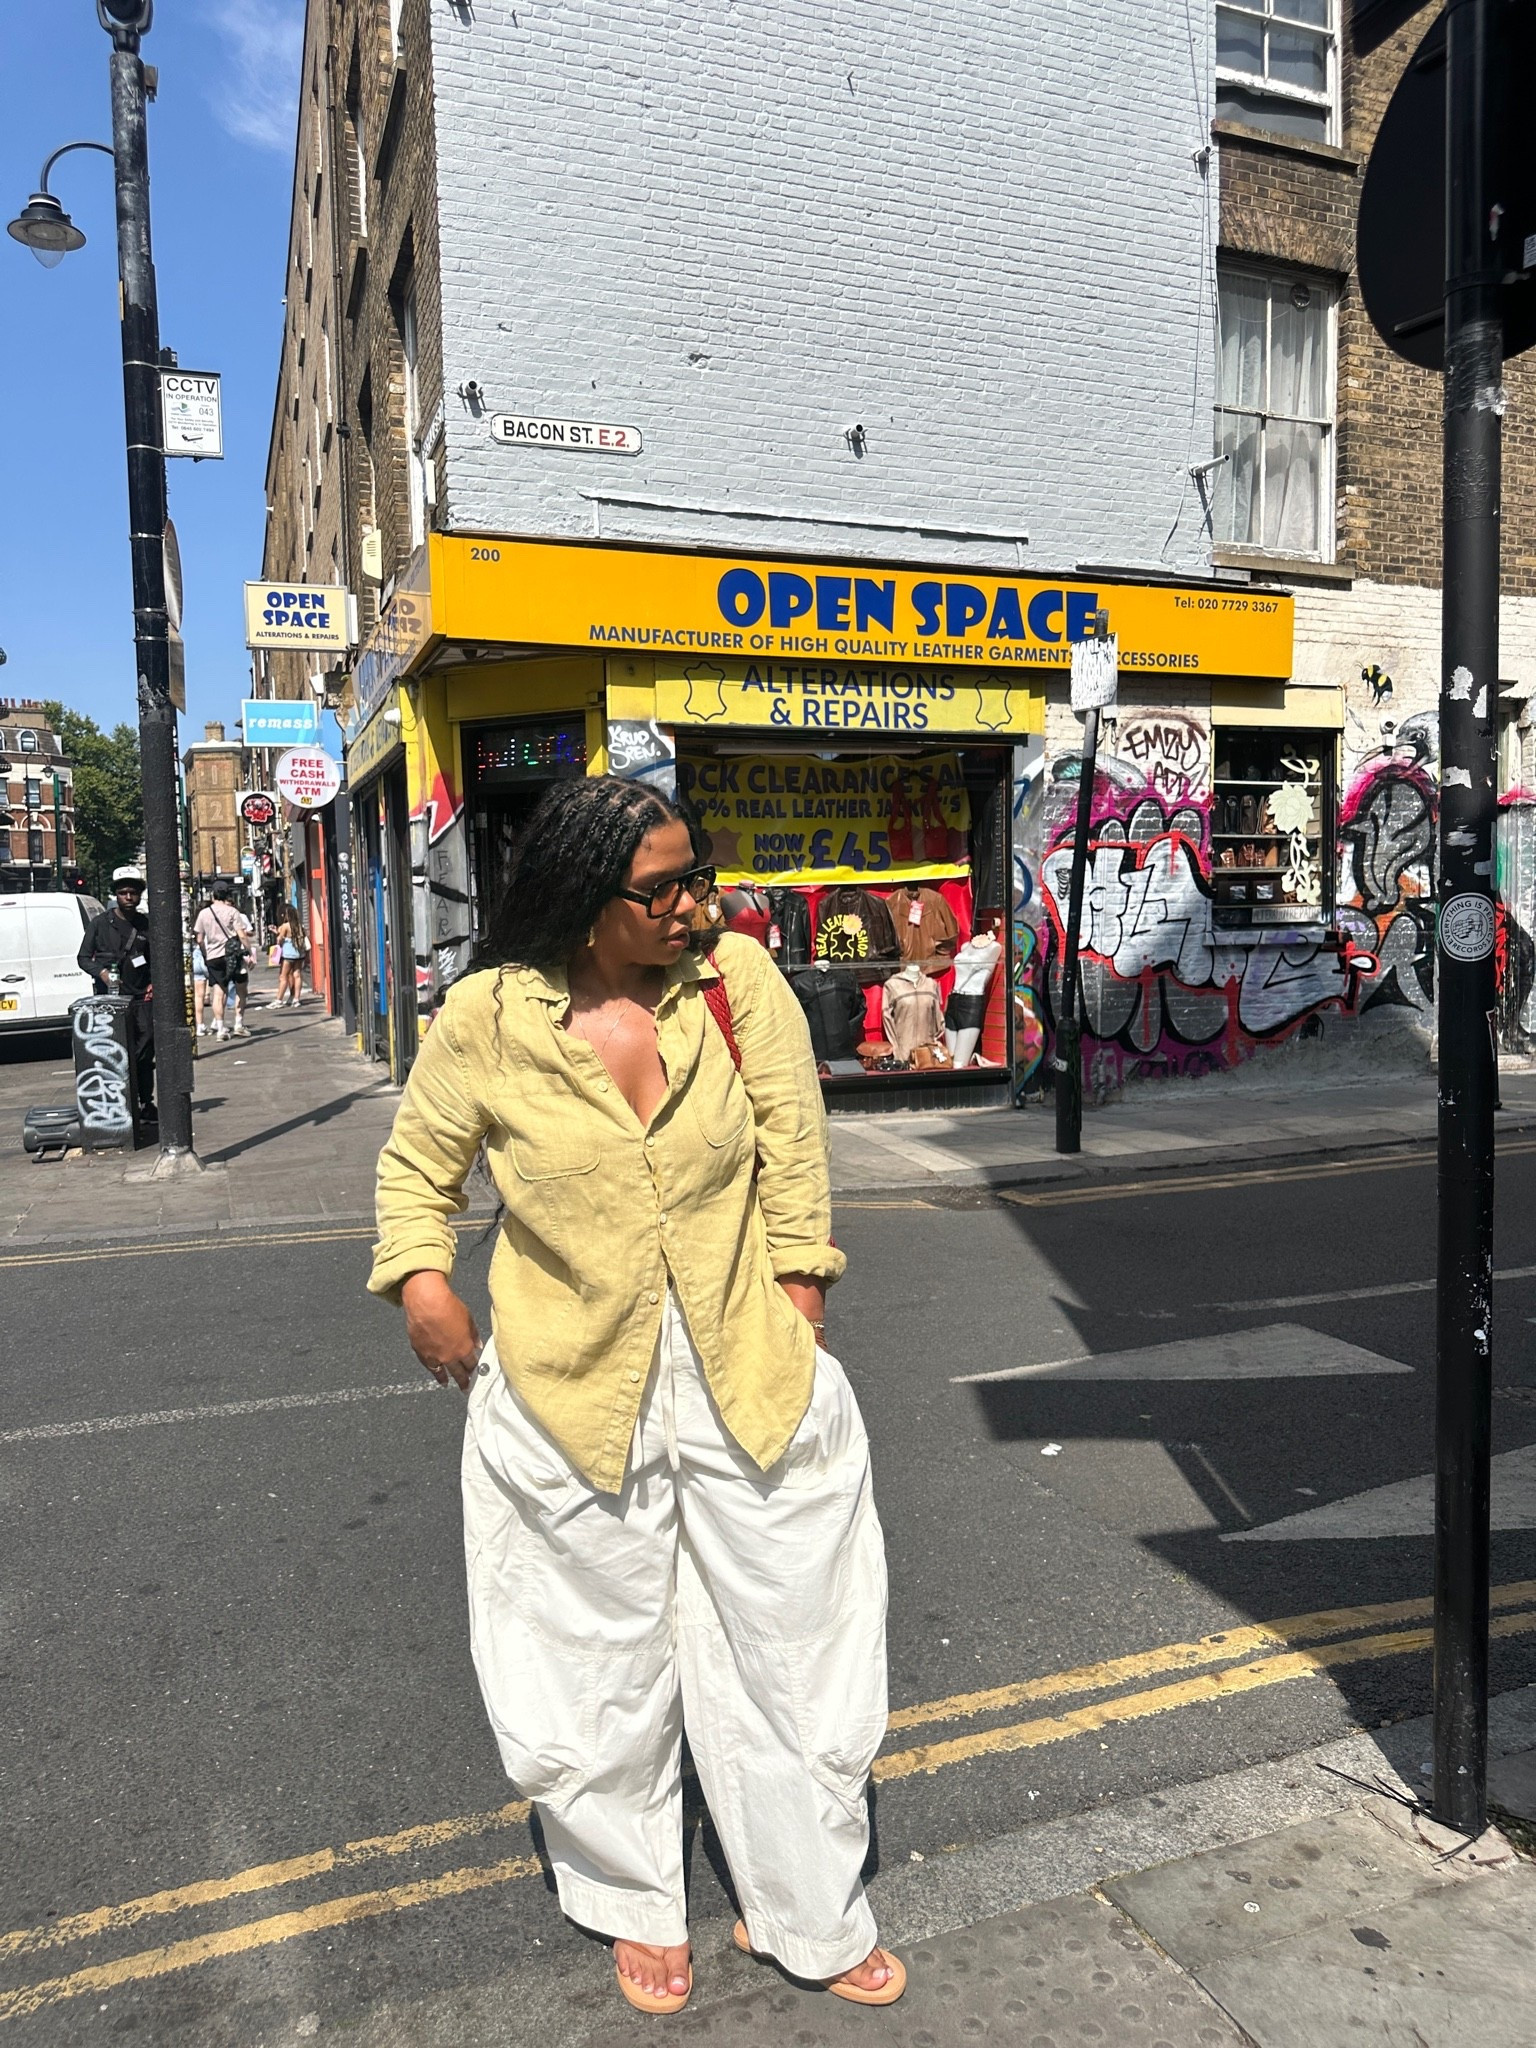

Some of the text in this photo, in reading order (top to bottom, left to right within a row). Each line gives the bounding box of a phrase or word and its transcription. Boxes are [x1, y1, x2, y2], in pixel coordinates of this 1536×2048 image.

[166, 377, 216, 394] CCTV
[175, 394, 217, 402] OPERATION
[198, 408, 214, 416] 043
[503, 420, 630, 448] BACON ST. E.2.
[470, 547, 500, 562] 200
[266, 592, 325, 609] OPEN
[717, 568, 1099, 643] OPEN SPACE
[1174, 596, 1279, 613] Tel: 020 7729 3367
[262, 610, 330, 628] SPACE
[589, 624, 744, 649] MANUFACTURER
[750, 634, 774, 650] OF
[780, 636, 828, 653] HIGH
[834, 638, 908, 656] QUALITY
[914, 642, 984, 660] LEATHER
[1117, 651, 1200, 668] CESSORIES
[741, 665, 956, 701] ALTERATIONS
[769, 697, 929, 730] & REPAIRS
[248, 718, 313, 730] remass
[292, 758, 324, 768] FREE
[280, 779, 336, 787] WITHDRAWALS
[290, 770, 325, 779] CASH
[747, 763, 912, 795] CLEARANCE
[294, 787, 321, 796] ATM
[210, 801, 224, 821] 2
[736, 799, 788, 818] REAL
[792, 798, 872, 818] LEATHER
[754, 833, 806, 853] NOW
[809, 829, 892, 872] £45
[752, 854, 806, 873] ONLY
[1443, 900, 1472, 946] EVERYTHING
[1483, 908, 1494, 944] PERFECT
[816, 914, 868, 958] REAL LEAT SHOP
[1452, 942, 1487, 954] RECORDS
[0, 1001, 15, 1010] CV
